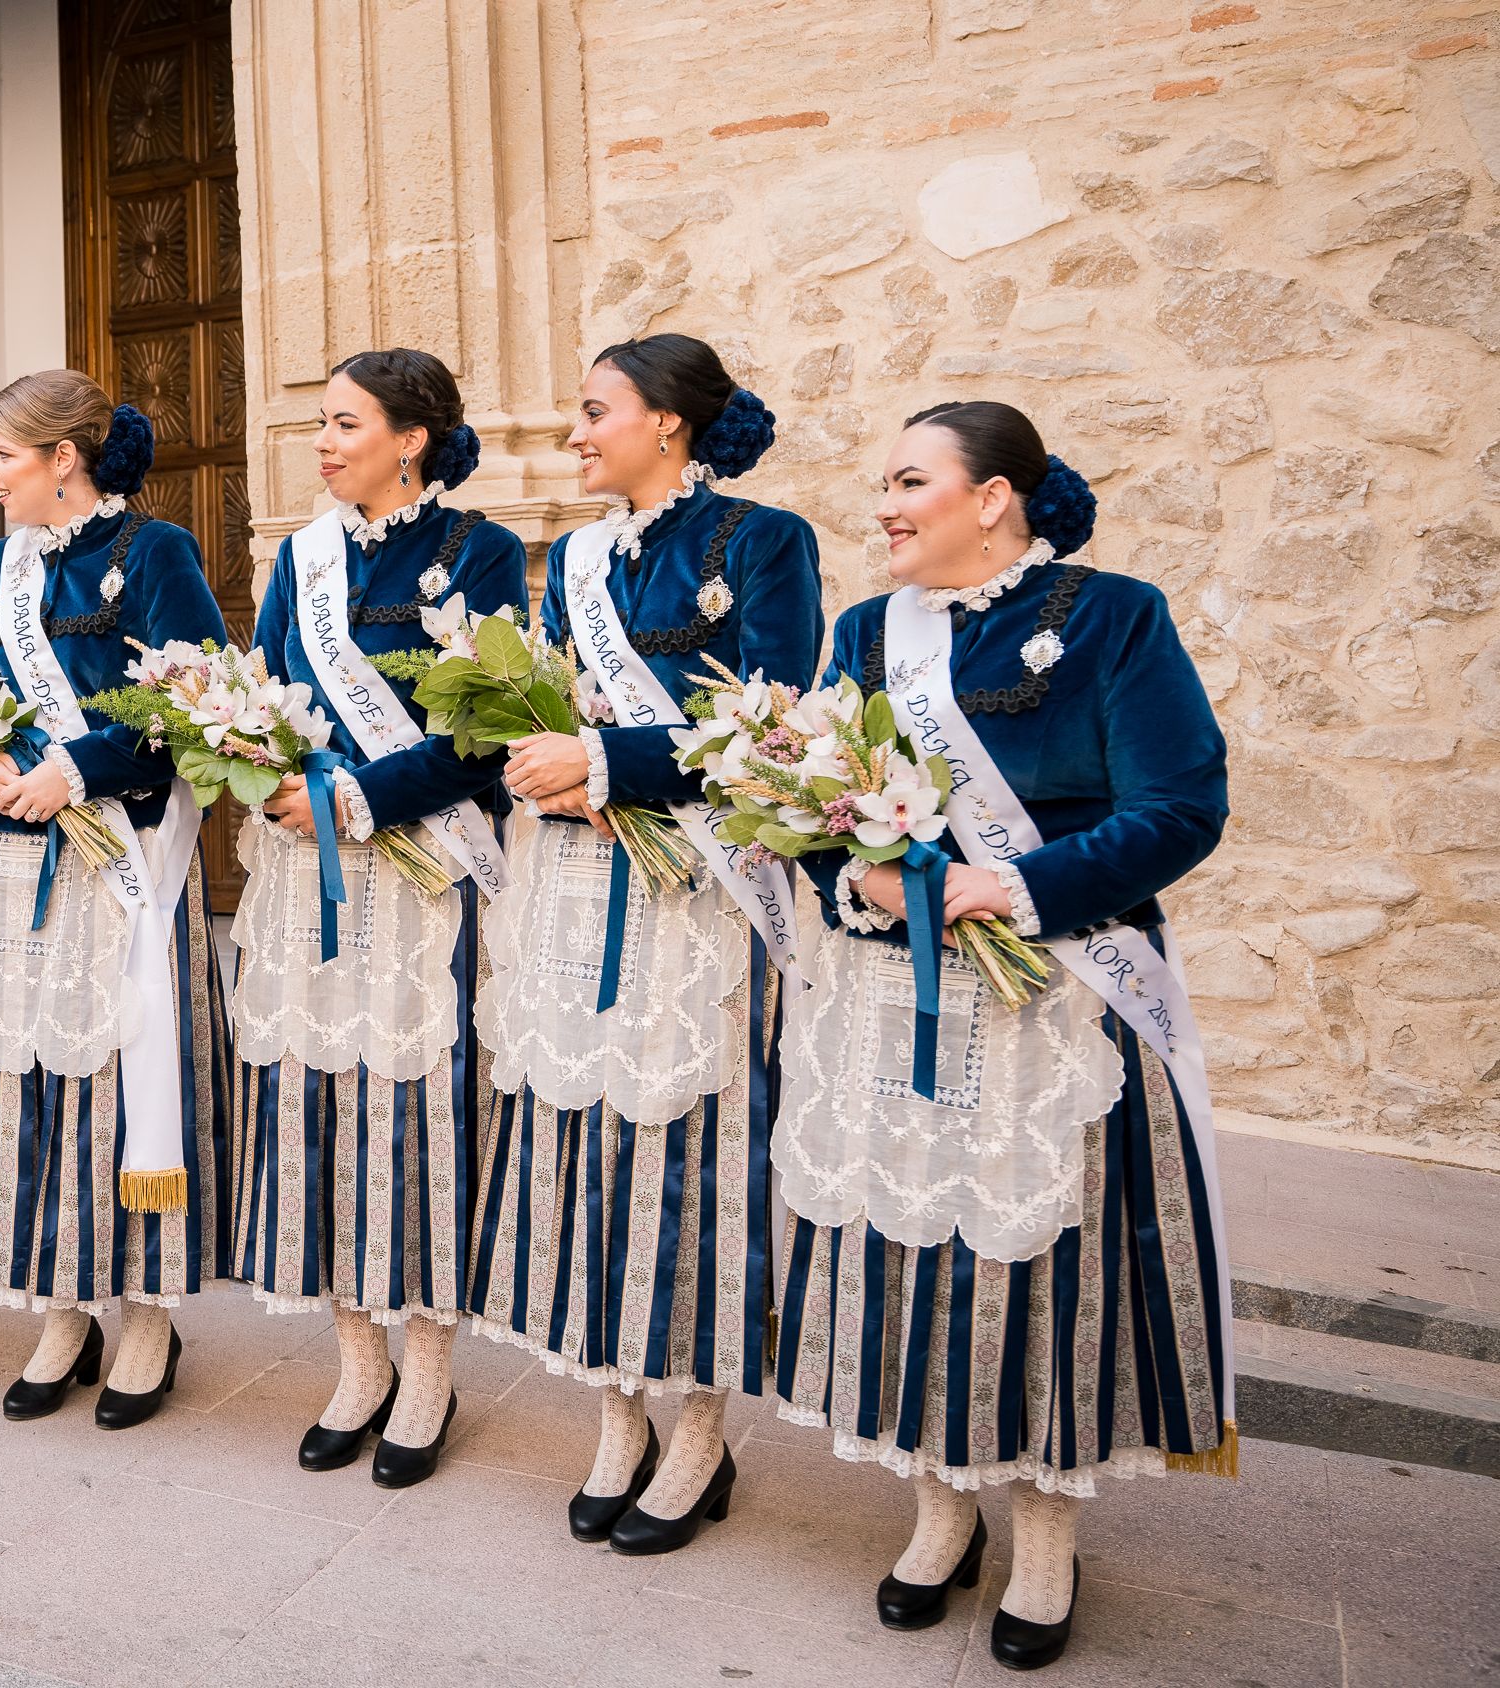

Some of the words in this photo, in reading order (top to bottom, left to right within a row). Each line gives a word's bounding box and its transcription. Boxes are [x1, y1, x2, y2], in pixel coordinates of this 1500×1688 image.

[13, 593, 38, 661] DAMA
[31, 679, 61, 718] DE
[311, 593, 341, 667] DAMA
[346, 685, 385, 723] DE
[585, 600, 627, 682] DAMA
[755, 889, 792, 945] 2026
